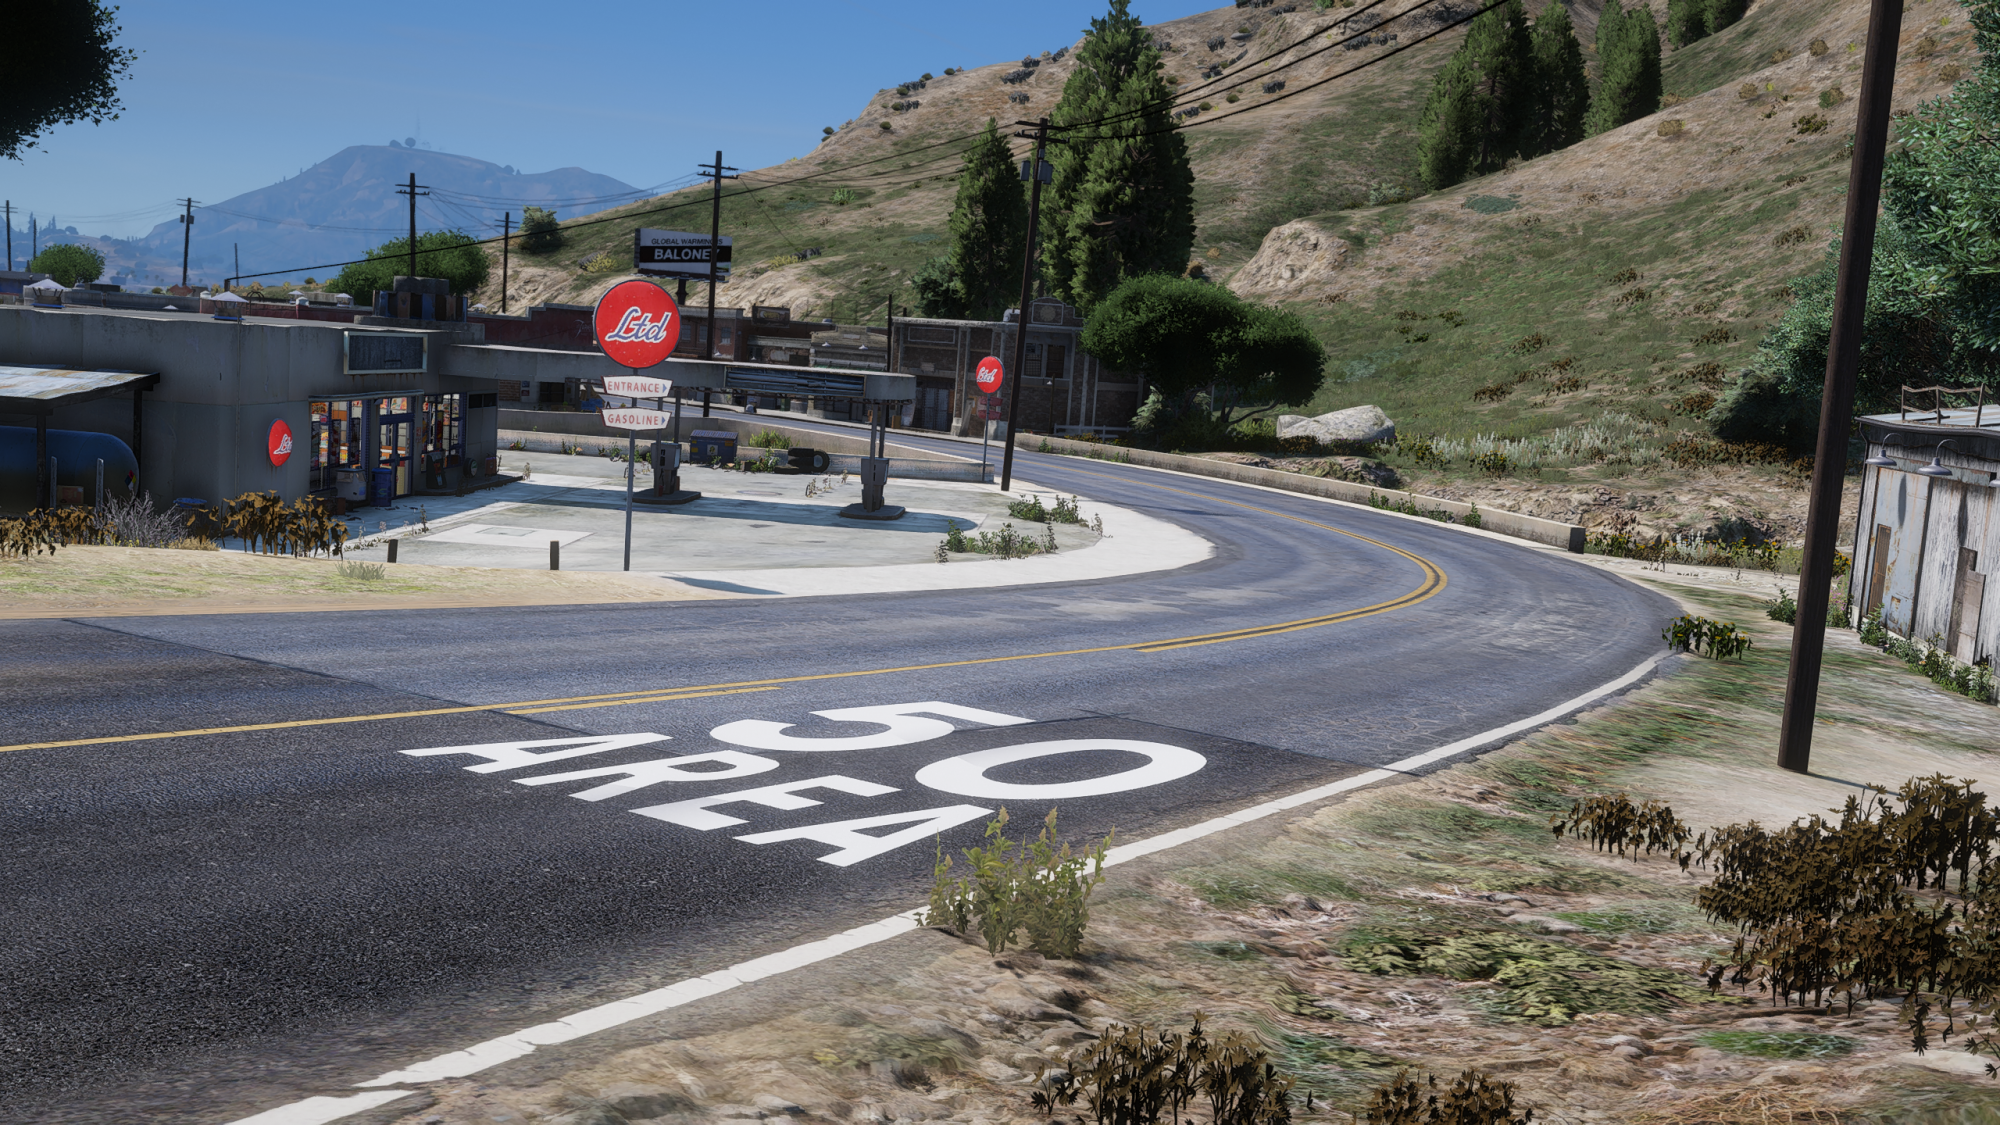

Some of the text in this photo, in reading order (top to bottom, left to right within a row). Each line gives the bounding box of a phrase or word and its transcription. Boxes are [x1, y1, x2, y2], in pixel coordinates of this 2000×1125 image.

[654, 248, 720, 260] BALONE
[605, 306, 672, 343] Ltd
[976, 367, 998, 383] Ltd
[607, 381, 660, 393] ENTRANCE
[607, 413, 659, 426] GASOLINE
[710, 701, 1207, 800] 50
[398, 732, 995, 867] AREA
